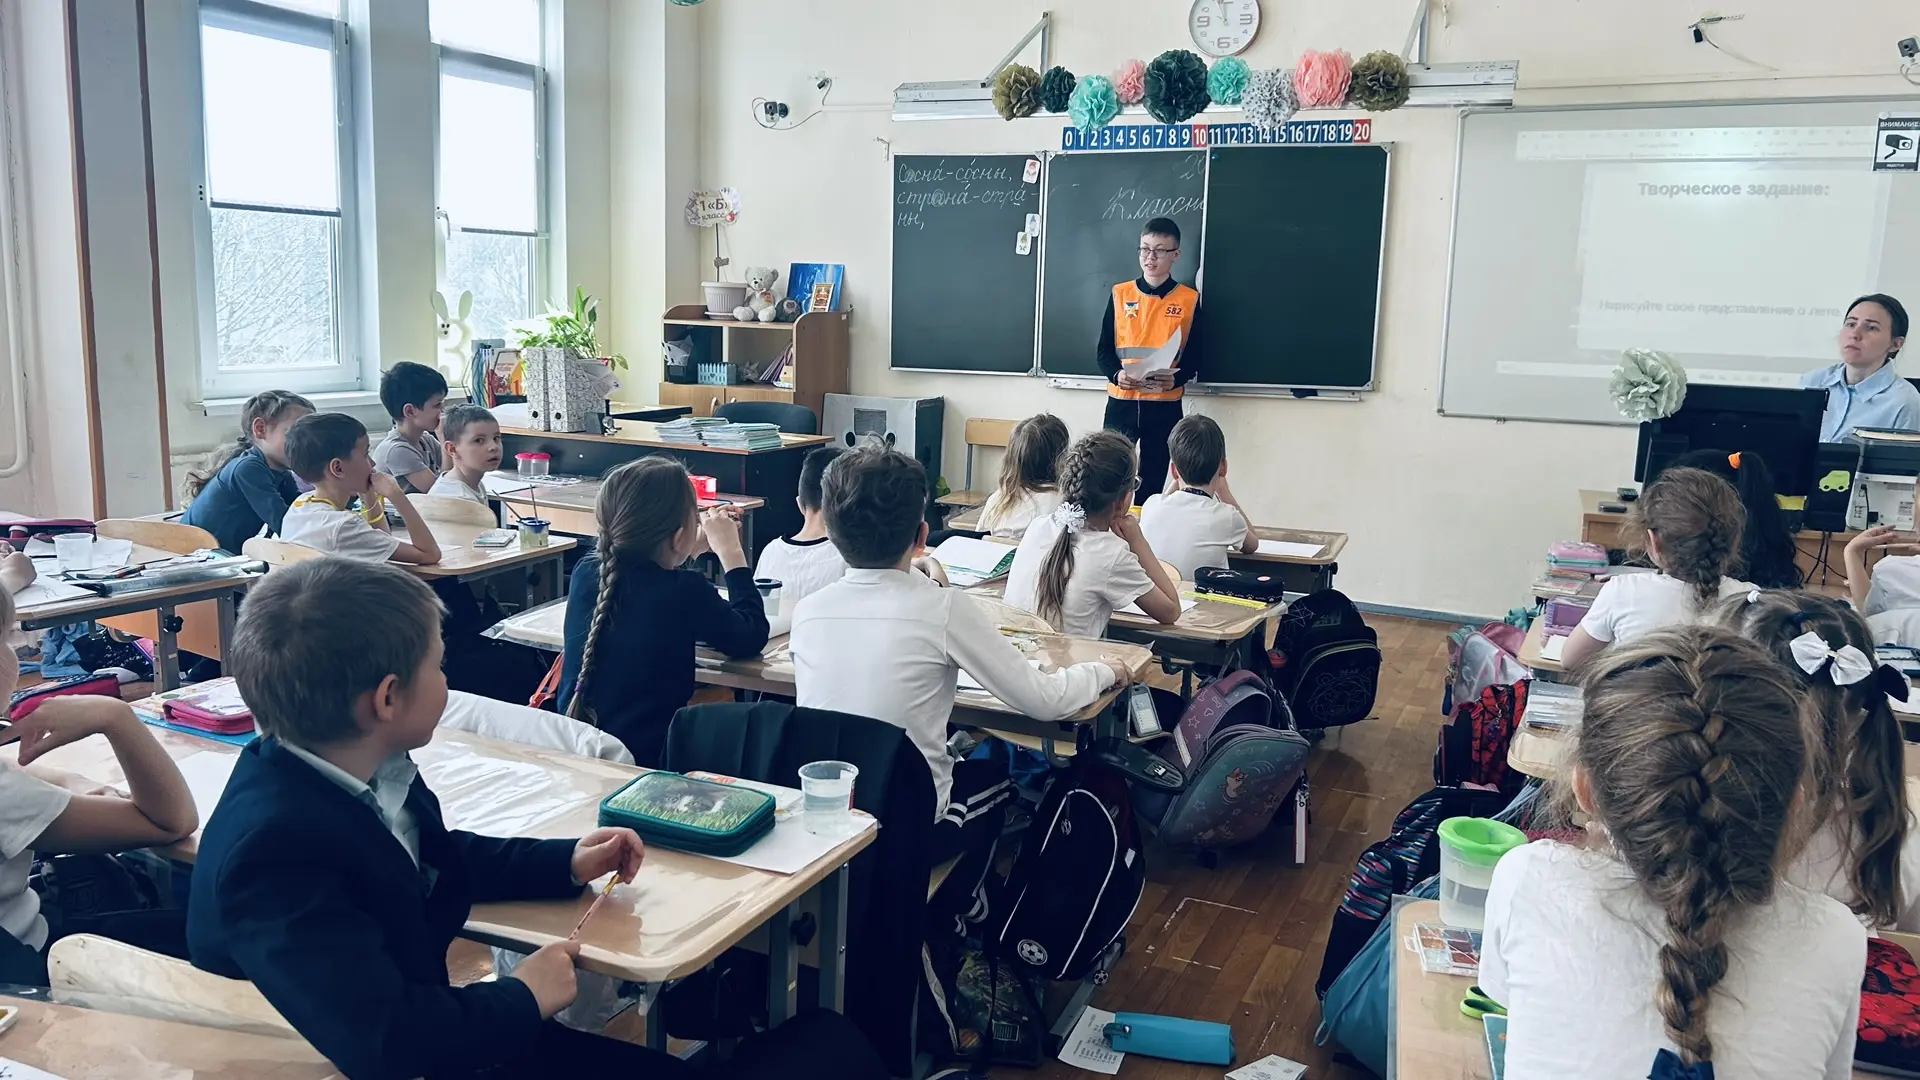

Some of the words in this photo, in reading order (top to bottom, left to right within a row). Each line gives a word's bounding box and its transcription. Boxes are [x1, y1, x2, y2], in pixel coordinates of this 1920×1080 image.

[1196, 15, 1210, 28] 9
[1239, 13, 1253, 25] 3
[1217, 36, 1231, 49] 6
[1065, 130, 1072, 146] 0
[1079, 131, 1084, 146] 1
[1090, 130, 1098, 146] 2
[1103, 130, 1110, 146] 3
[1116, 129, 1124, 146] 4
[1130, 129, 1136, 146] 5
[1142, 128, 1150, 146] 6
[1156, 128, 1163, 146] 7
[1168, 128, 1176, 146] 8
[1182, 128, 1190, 145] 9
[1194, 128, 1206, 145] 10
[1209, 128, 1221, 144] 11
[1225, 127, 1238, 144] 12
[1241, 127, 1254, 144] 13
[1257, 127, 1271, 143] 14
[1274, 126, 1286, 142] 15
[1290, 125, 1303, 142] 16
[1306, 124, 1320, 142] 17
[1322, 124, 1336, 142] 18
[1338, 124, 1352, 141] 19
[1354, 123, 1370, 140] 20
[1637, 181, 1742, 198] Творческое
[1746, 183, 1831, 199] задание:
[699, 200, 706, 211] 1
[701, 212, 725, 221] класс
[1165, 306, 1182, 315] 582
[1599, 299, 1663, 314] Нарисуйте
[1697, 303, 1795, 316] представление
[1797, 307, 1806, 316] о
